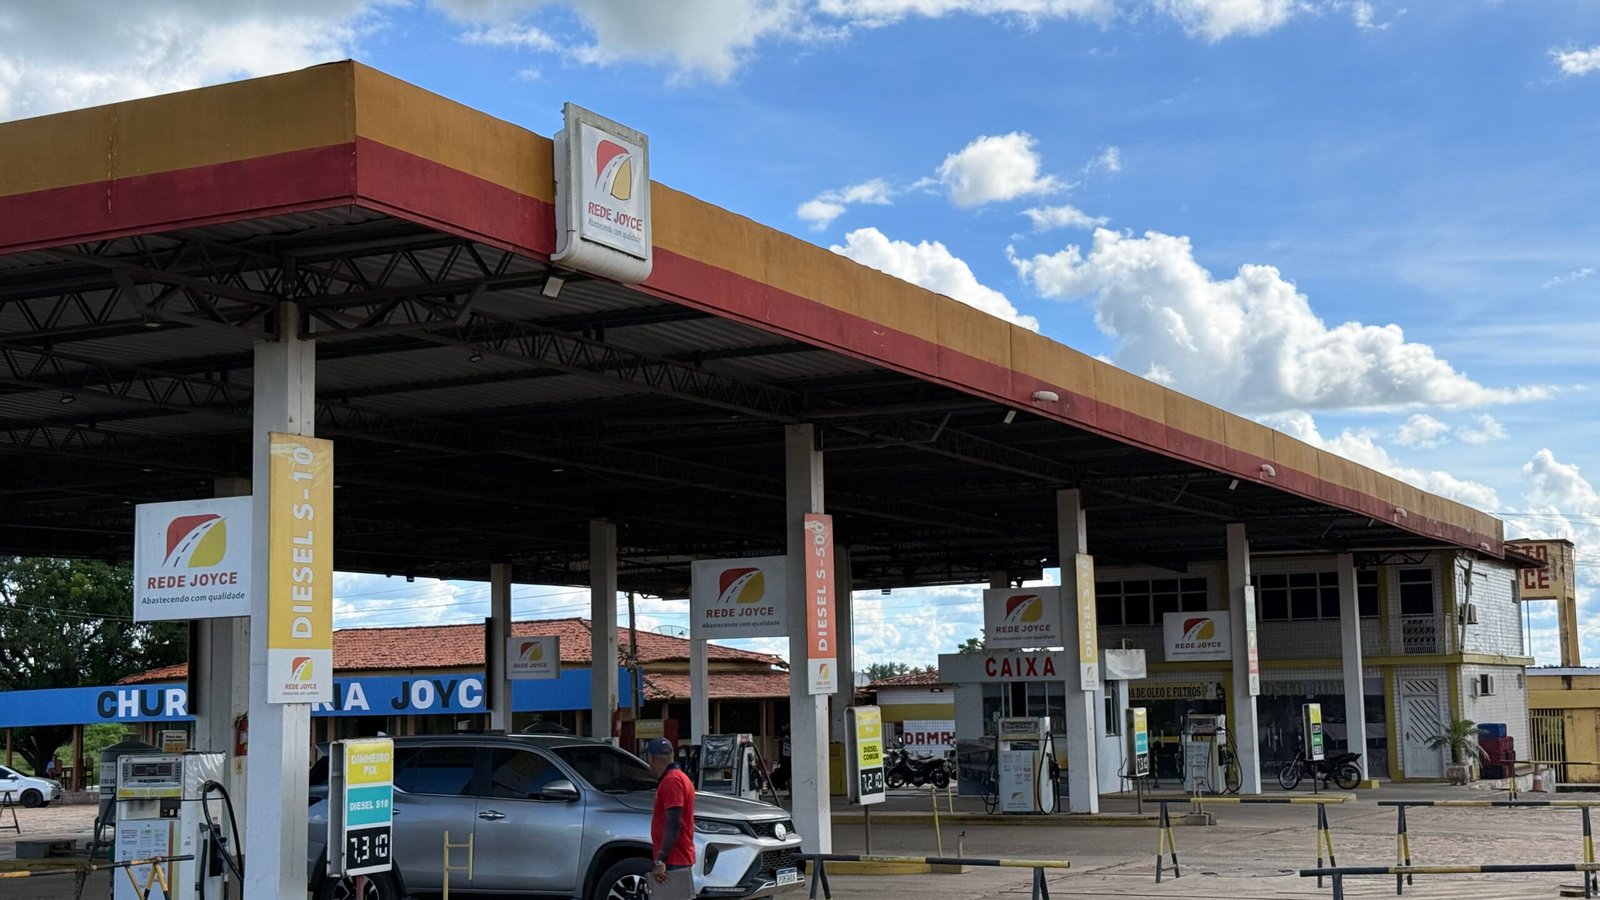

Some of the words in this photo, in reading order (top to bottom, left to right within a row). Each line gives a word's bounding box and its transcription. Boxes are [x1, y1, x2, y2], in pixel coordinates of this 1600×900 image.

[588, 201, 612, 221] REDE
[613, 211, 643, 232] JOYCE
[292, 446, 314, 521] S-10
[815, 520, 826, 579] S-500
[147, 575, 186, 590] REDE
[189, 572, 238, 587] JOYCE
[291, 530, 314, 640] DIESEL
[141, 594, 190, 605] Abastecendo
[190, 594, 207, 602] com
[208, 592, 245, 603] qualidade
[706, 608, 735, 618] REDE
[738, 606, 774, 617] JOYCE
[817, 584, 828, 652] DIESEL
[995, 625, 1019, 634] REDE
[1021, 624, 1052, 633] JOYCE
[1083, 605, 1093, 658] DIESEL
[985, 656, 1056, 678] CAIXA
[391, 678, 486, 710] JOYC
[1136, 687, 1146, 698] DE
[1166, 687, 1172, 698] E
[1173, 686, 1201, 698] FILTROS
[351, 753, 390, 764] DINHEIRO
[363, 764, 378, 776] PIX
[349, 801, 374, 812] DIESEL
[375, 799, 389, 809] S10
